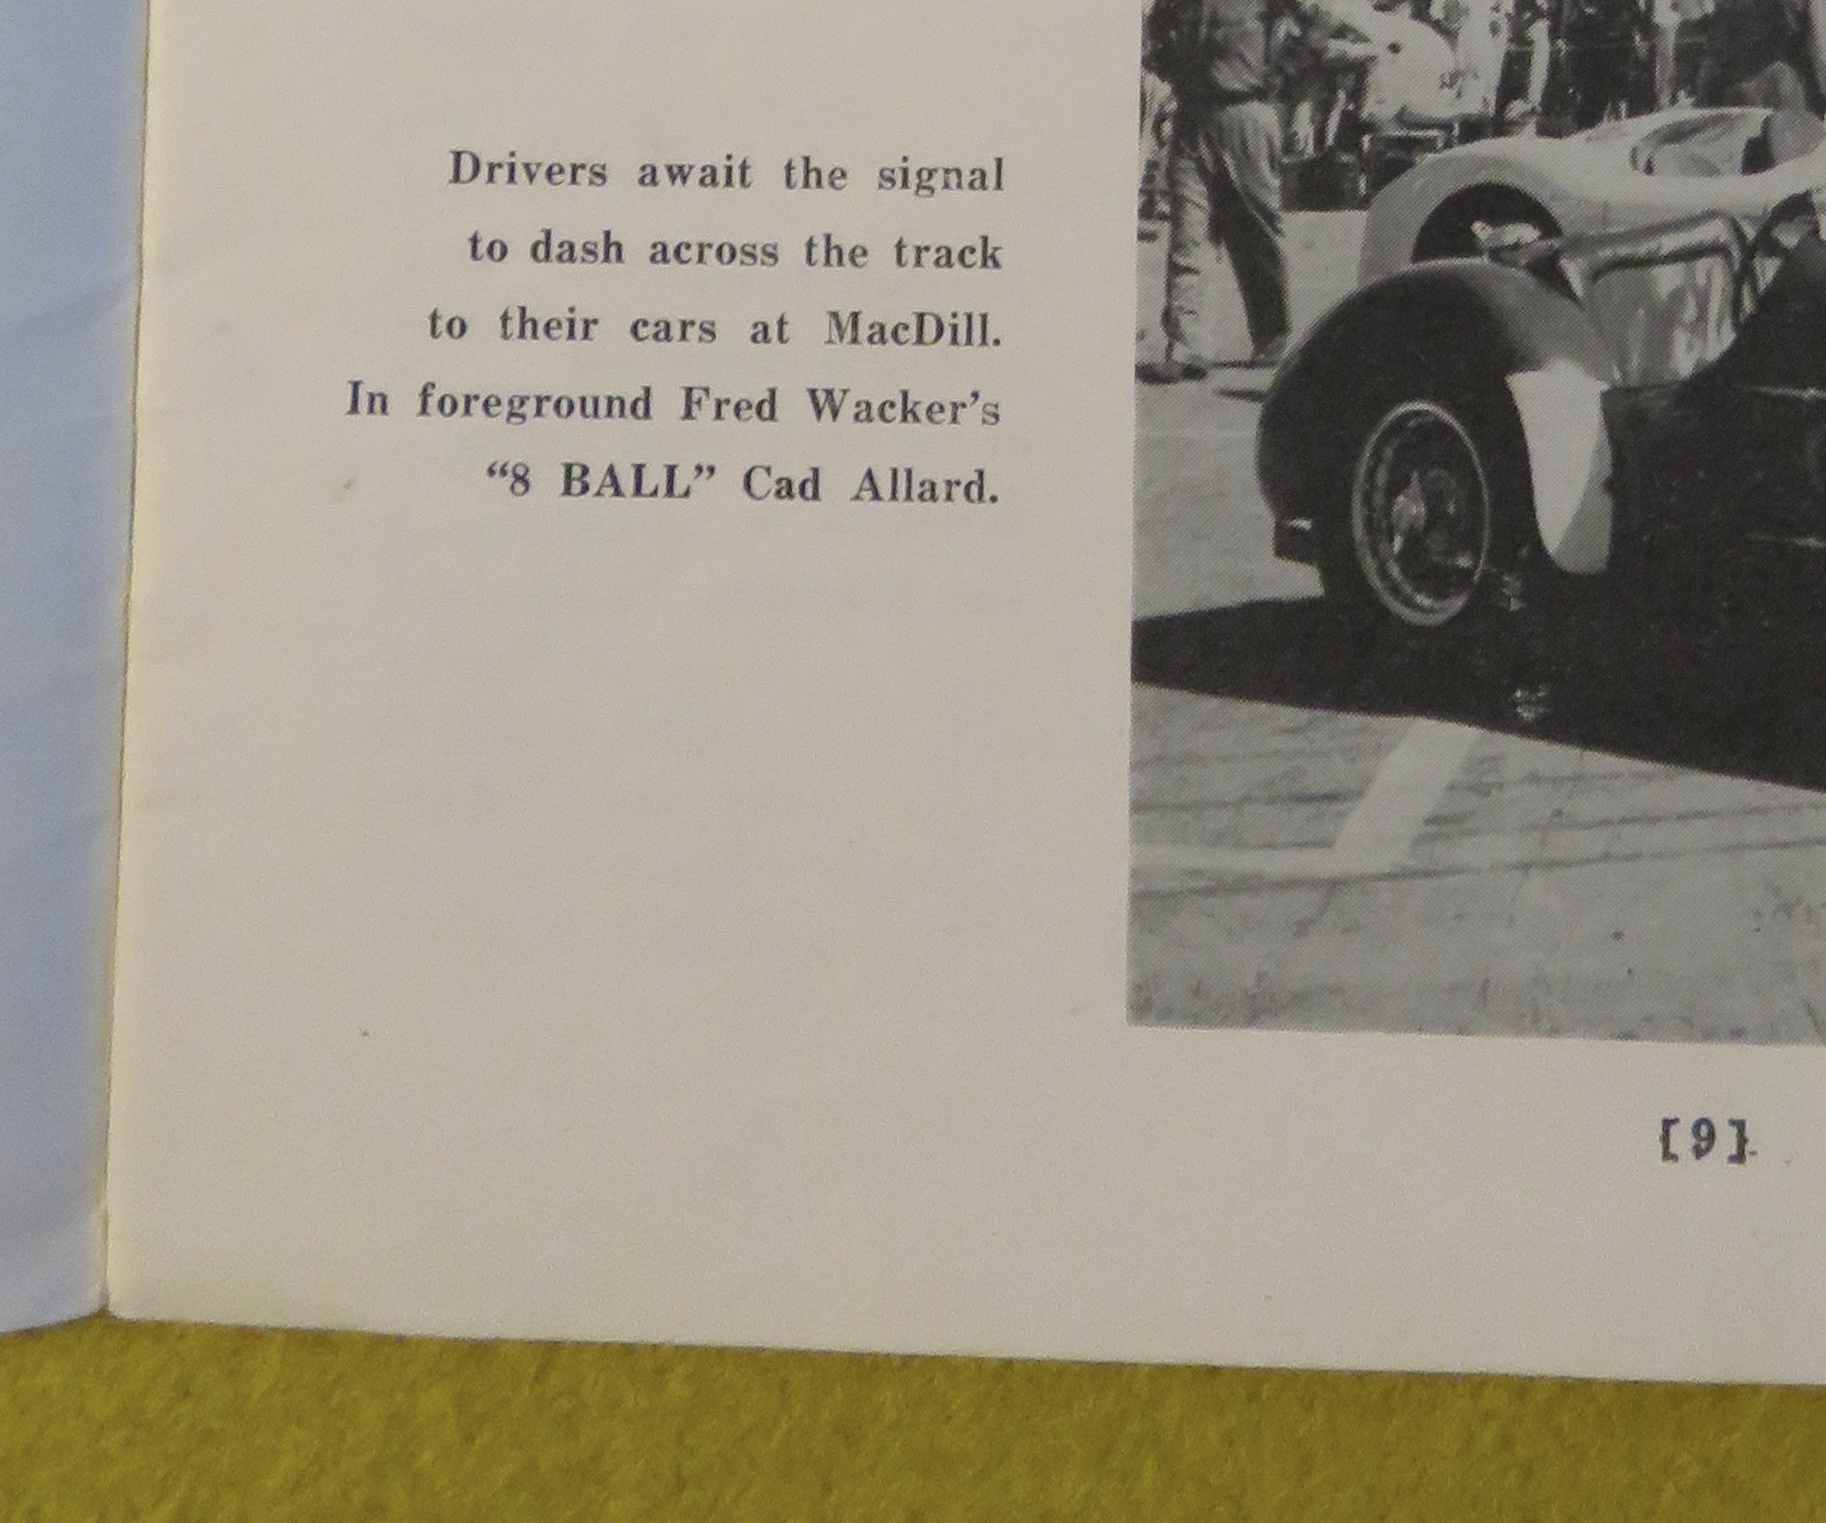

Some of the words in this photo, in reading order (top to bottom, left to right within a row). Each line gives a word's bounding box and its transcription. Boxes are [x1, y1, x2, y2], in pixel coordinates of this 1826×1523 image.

[449, 150, 608, 187] Drivers
[637, 153, 751, 189] await
[784, 155, 848, 191] the
[878, 155, 1004, 197] signal
[468, 231, 509, 263] to
[530, 228, 624, 264] dash
[649, 241, 779, 266] across
[805, 232, 869, 268] the
[894, 234, 1002, 270] track
[429, 308, 468, 340] to
[499, 305, 599, 341] their
[629, 318, 717, 343] cars
[750, 313, 789, 345] at
[826, 310, 1001, 347] MacDill.
[347, 380, 388, 416] In
[418, 381, 652, 424] foreground
[681, 386, 777, 422] Fred
[743, 465, 821, 502] Cad
[852, 467, 999, 504] Allard.
